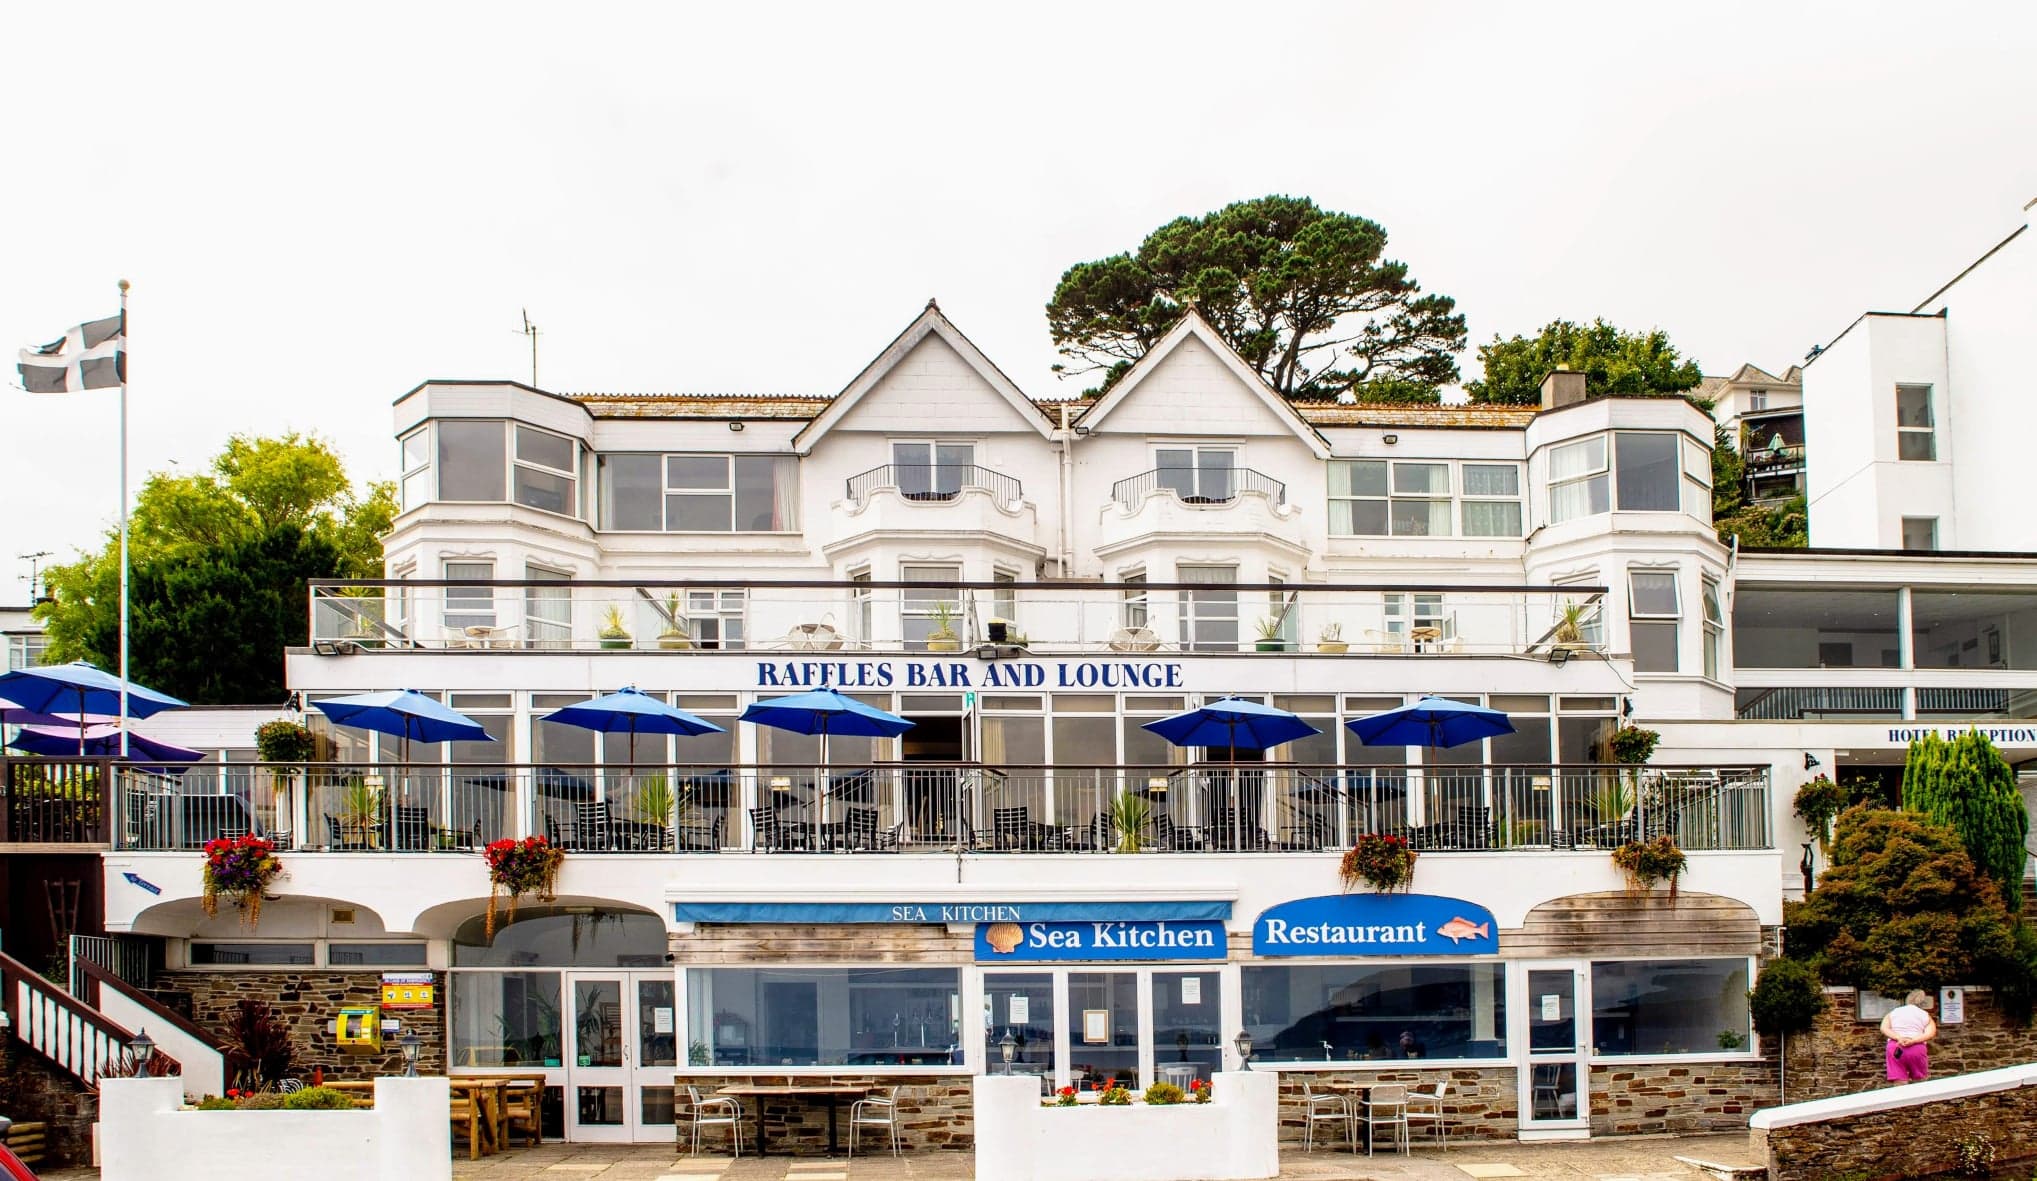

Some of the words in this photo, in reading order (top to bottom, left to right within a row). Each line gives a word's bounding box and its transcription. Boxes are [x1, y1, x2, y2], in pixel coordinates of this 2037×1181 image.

[757, 662, 893, 687] RAFFLES
[907, 662, 972, 687] BAR
[981, 662, 1045, 687] AND
[1057, 663, 1183, 688] LOUNGE
[892, 906, 926, 921] SEA
[942, 906, 1020, 921] KITCHEN
[1029, 922, 1082, 948] Sea
[1091, 921, 1215, 948] Kitchen
[1265, 918, 1427, 944] Restaurant
